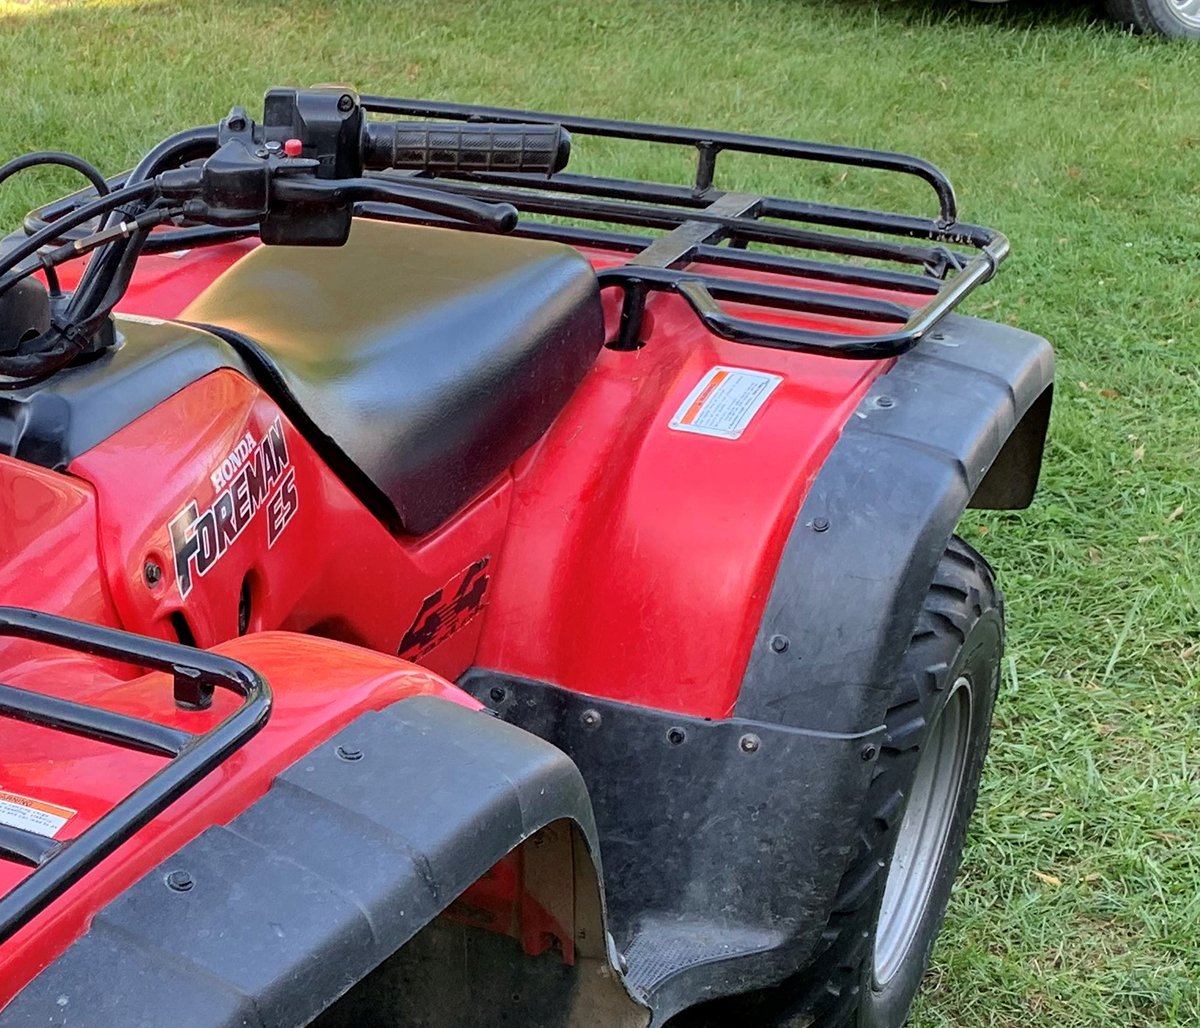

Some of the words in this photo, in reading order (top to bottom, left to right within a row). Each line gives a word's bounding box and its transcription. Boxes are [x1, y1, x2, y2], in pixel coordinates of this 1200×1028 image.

[211, 431, 257, 494] HONDA
[168, 414, 289, 601] FOREMAN
[267, 465, 298, 549] ES
